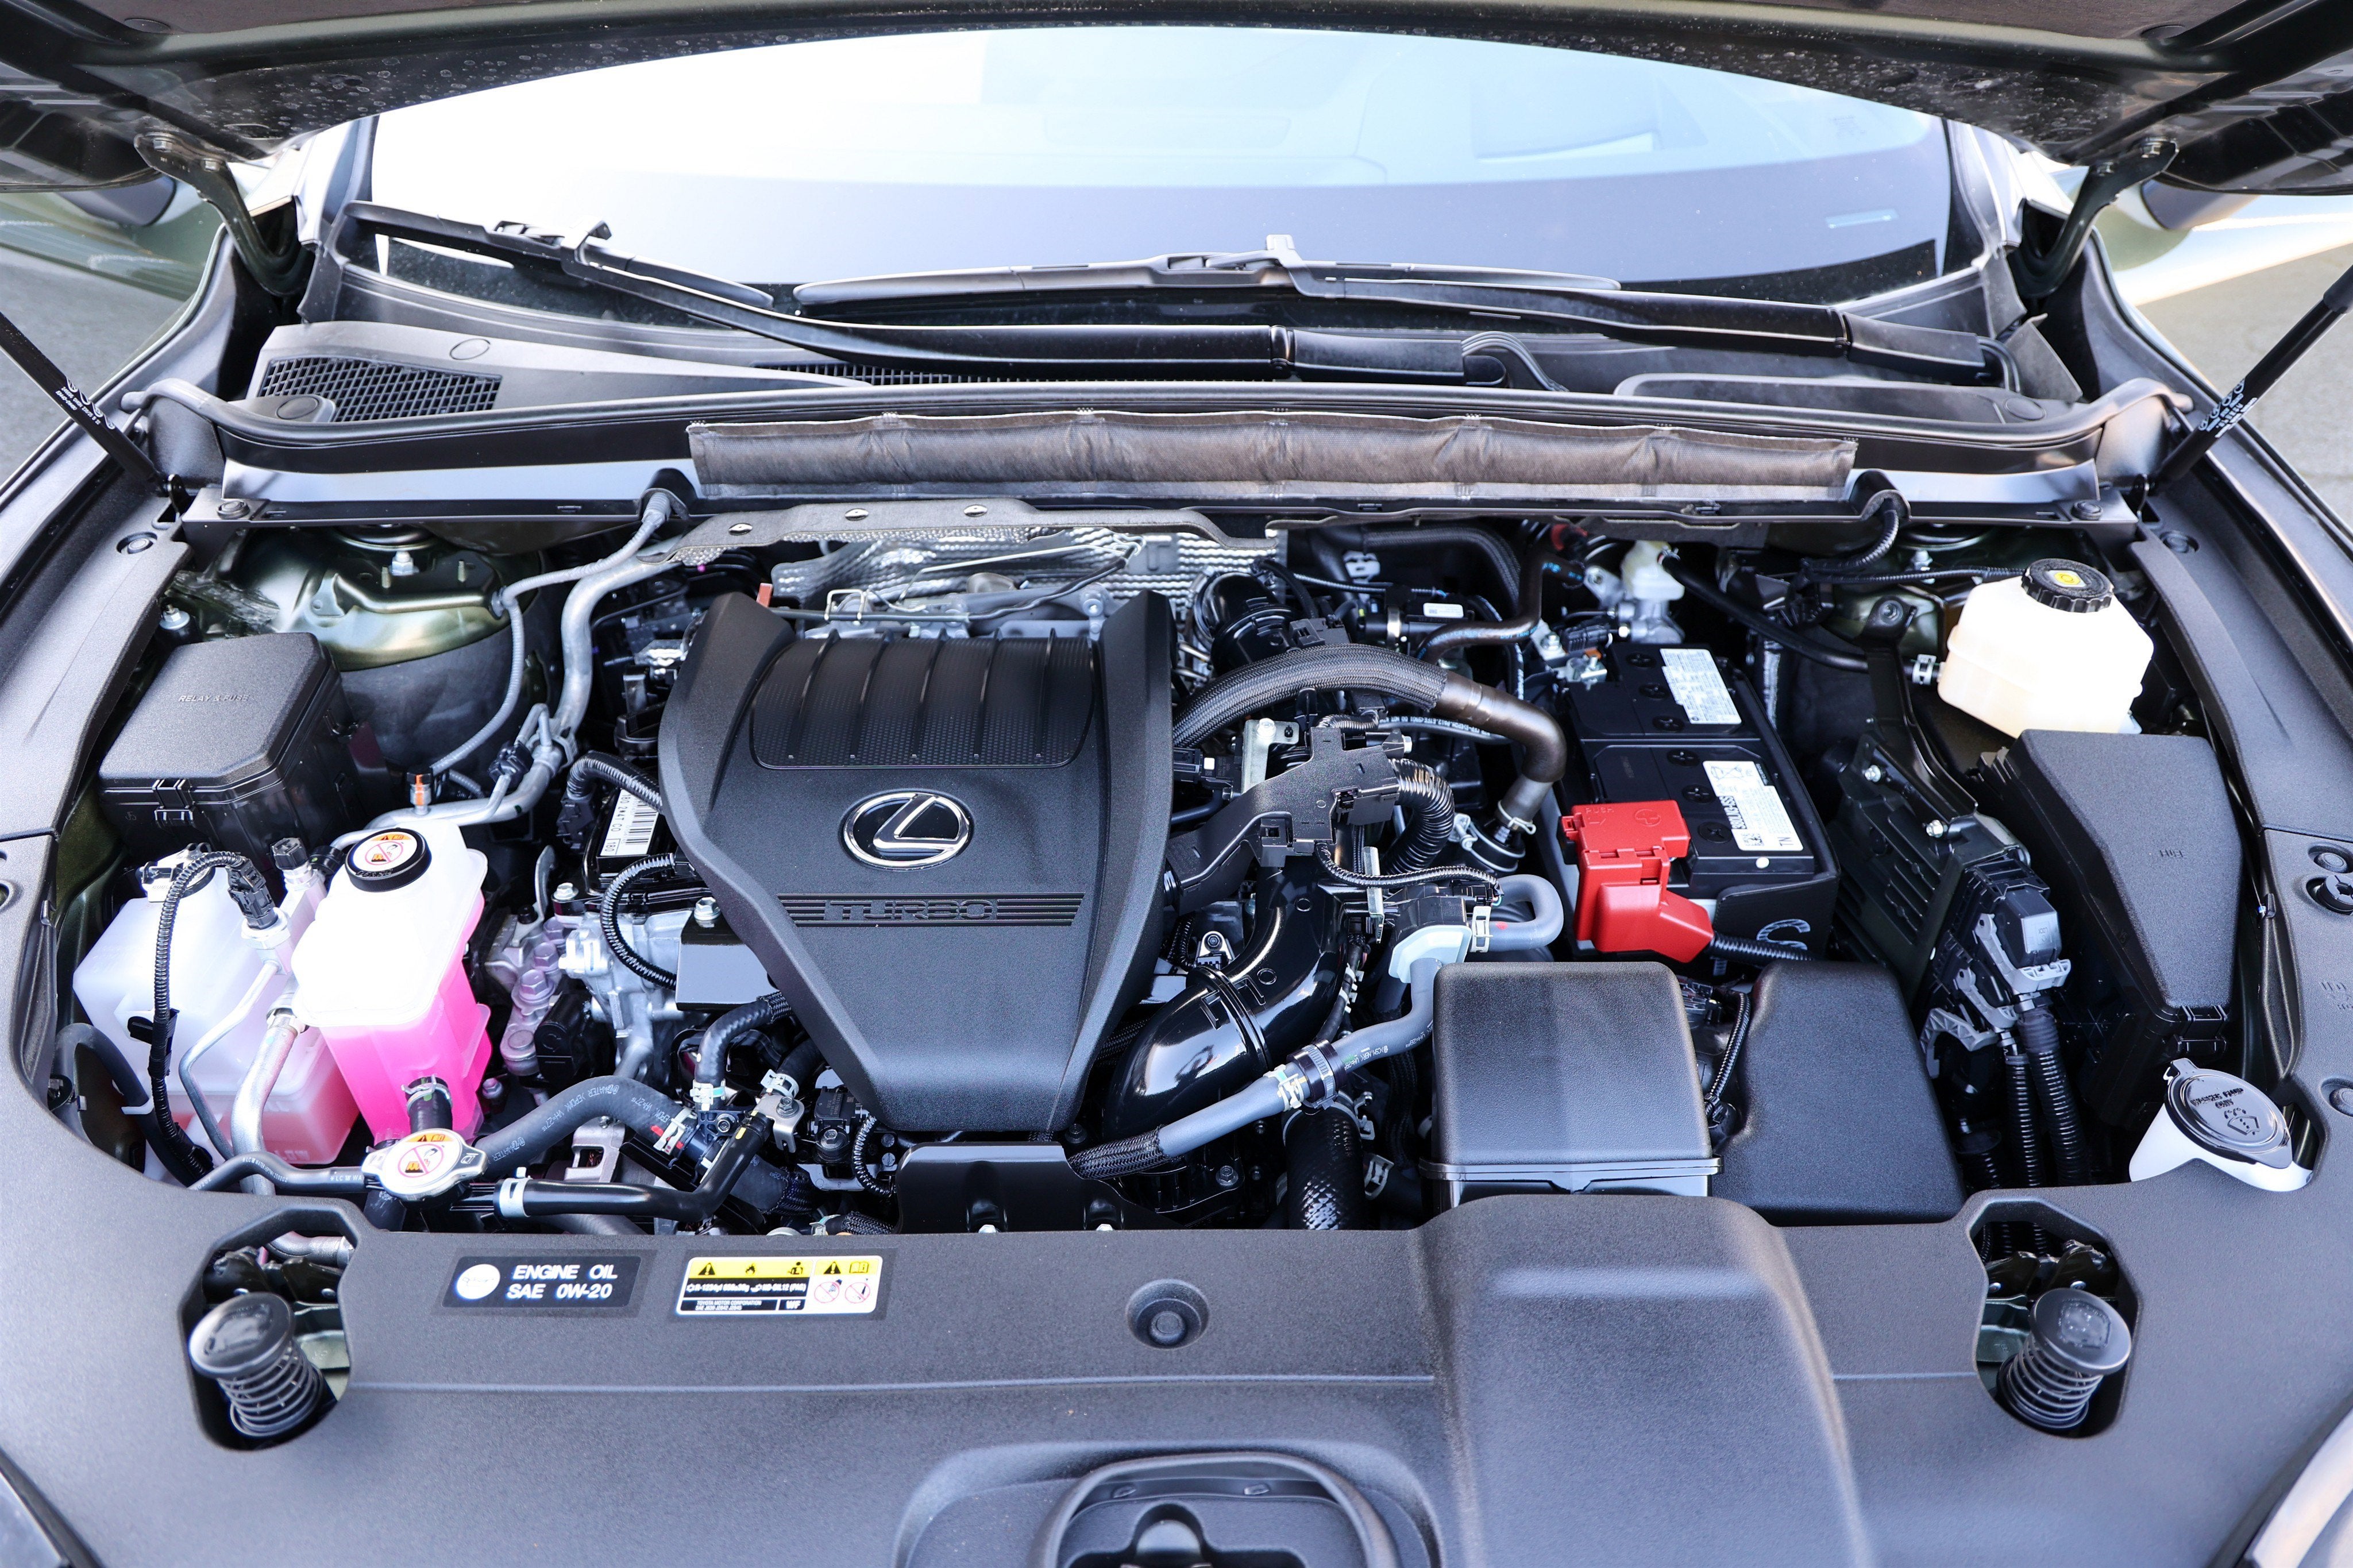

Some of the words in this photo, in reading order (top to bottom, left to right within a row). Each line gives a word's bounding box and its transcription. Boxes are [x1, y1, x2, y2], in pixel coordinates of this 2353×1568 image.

[604, 842, 616, 852] 180
[1777, 837, 1793, 847] TN
[830, 899, 993, 920] TURBO
[512, 1264, 581, 1280] ENGINE
[589, 1264, 618, 1280] OIL
[507, 1283, 546, 1299] SAE
[556, 1283, 614, 1299] 0W-20
[785, 1300, 801, 1310] WF
